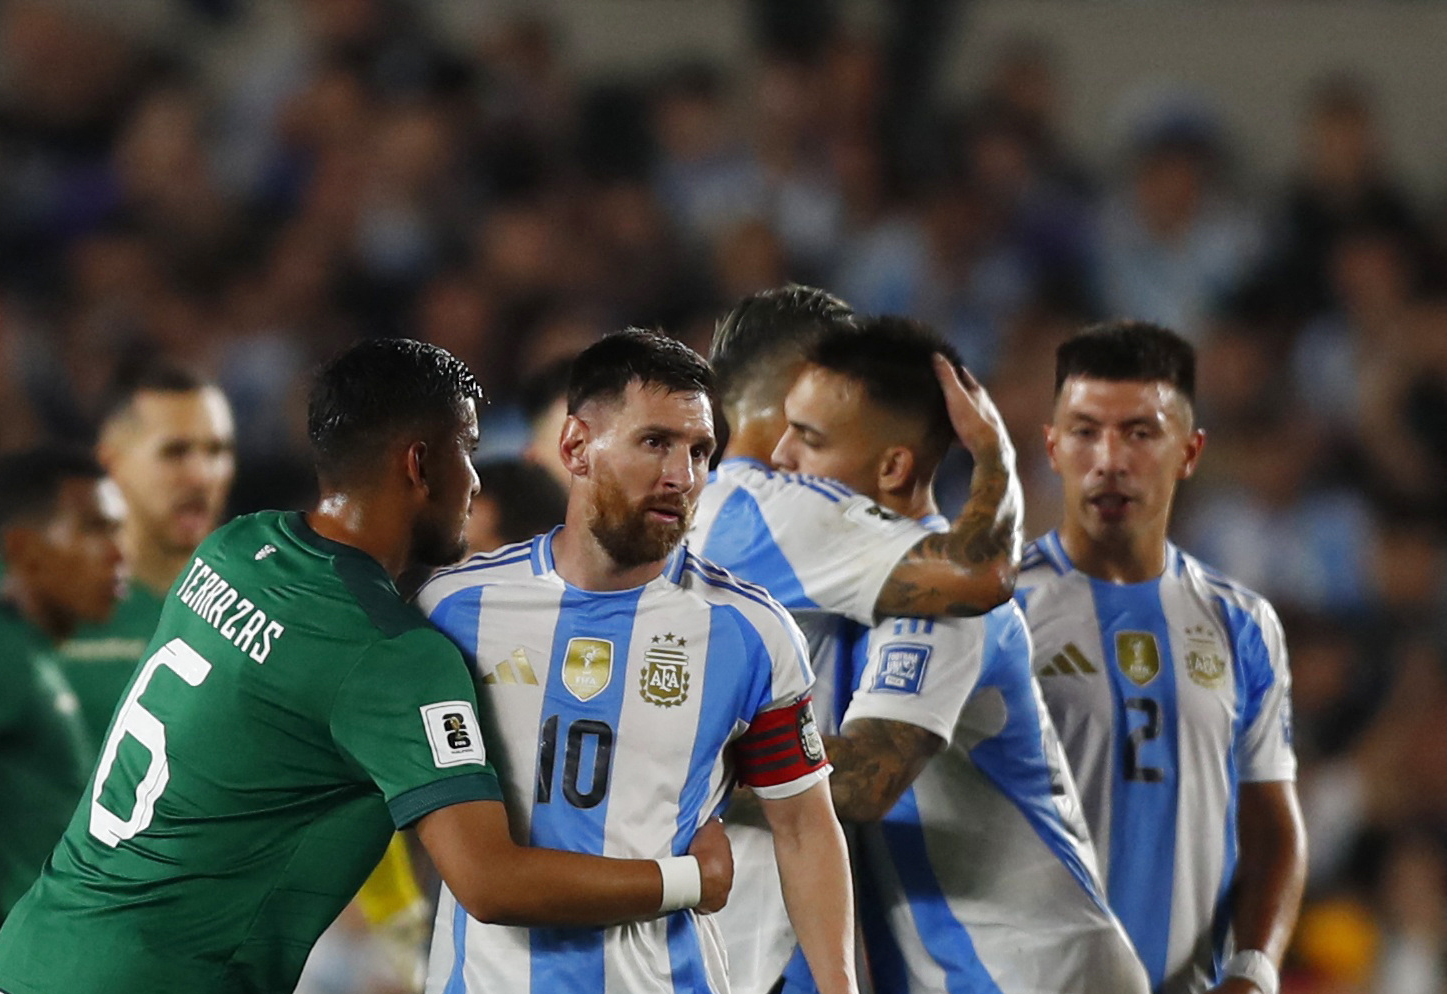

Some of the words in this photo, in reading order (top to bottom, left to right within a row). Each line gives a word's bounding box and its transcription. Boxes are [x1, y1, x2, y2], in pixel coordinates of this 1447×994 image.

[176, 557, 285, 664] TERRAZAS
[649, 663, 680, 692] AFA
[89, 637, 213, 848] 6
[536, 714, 613, 809] 10
[1123, 697, 1165, 781] 2
